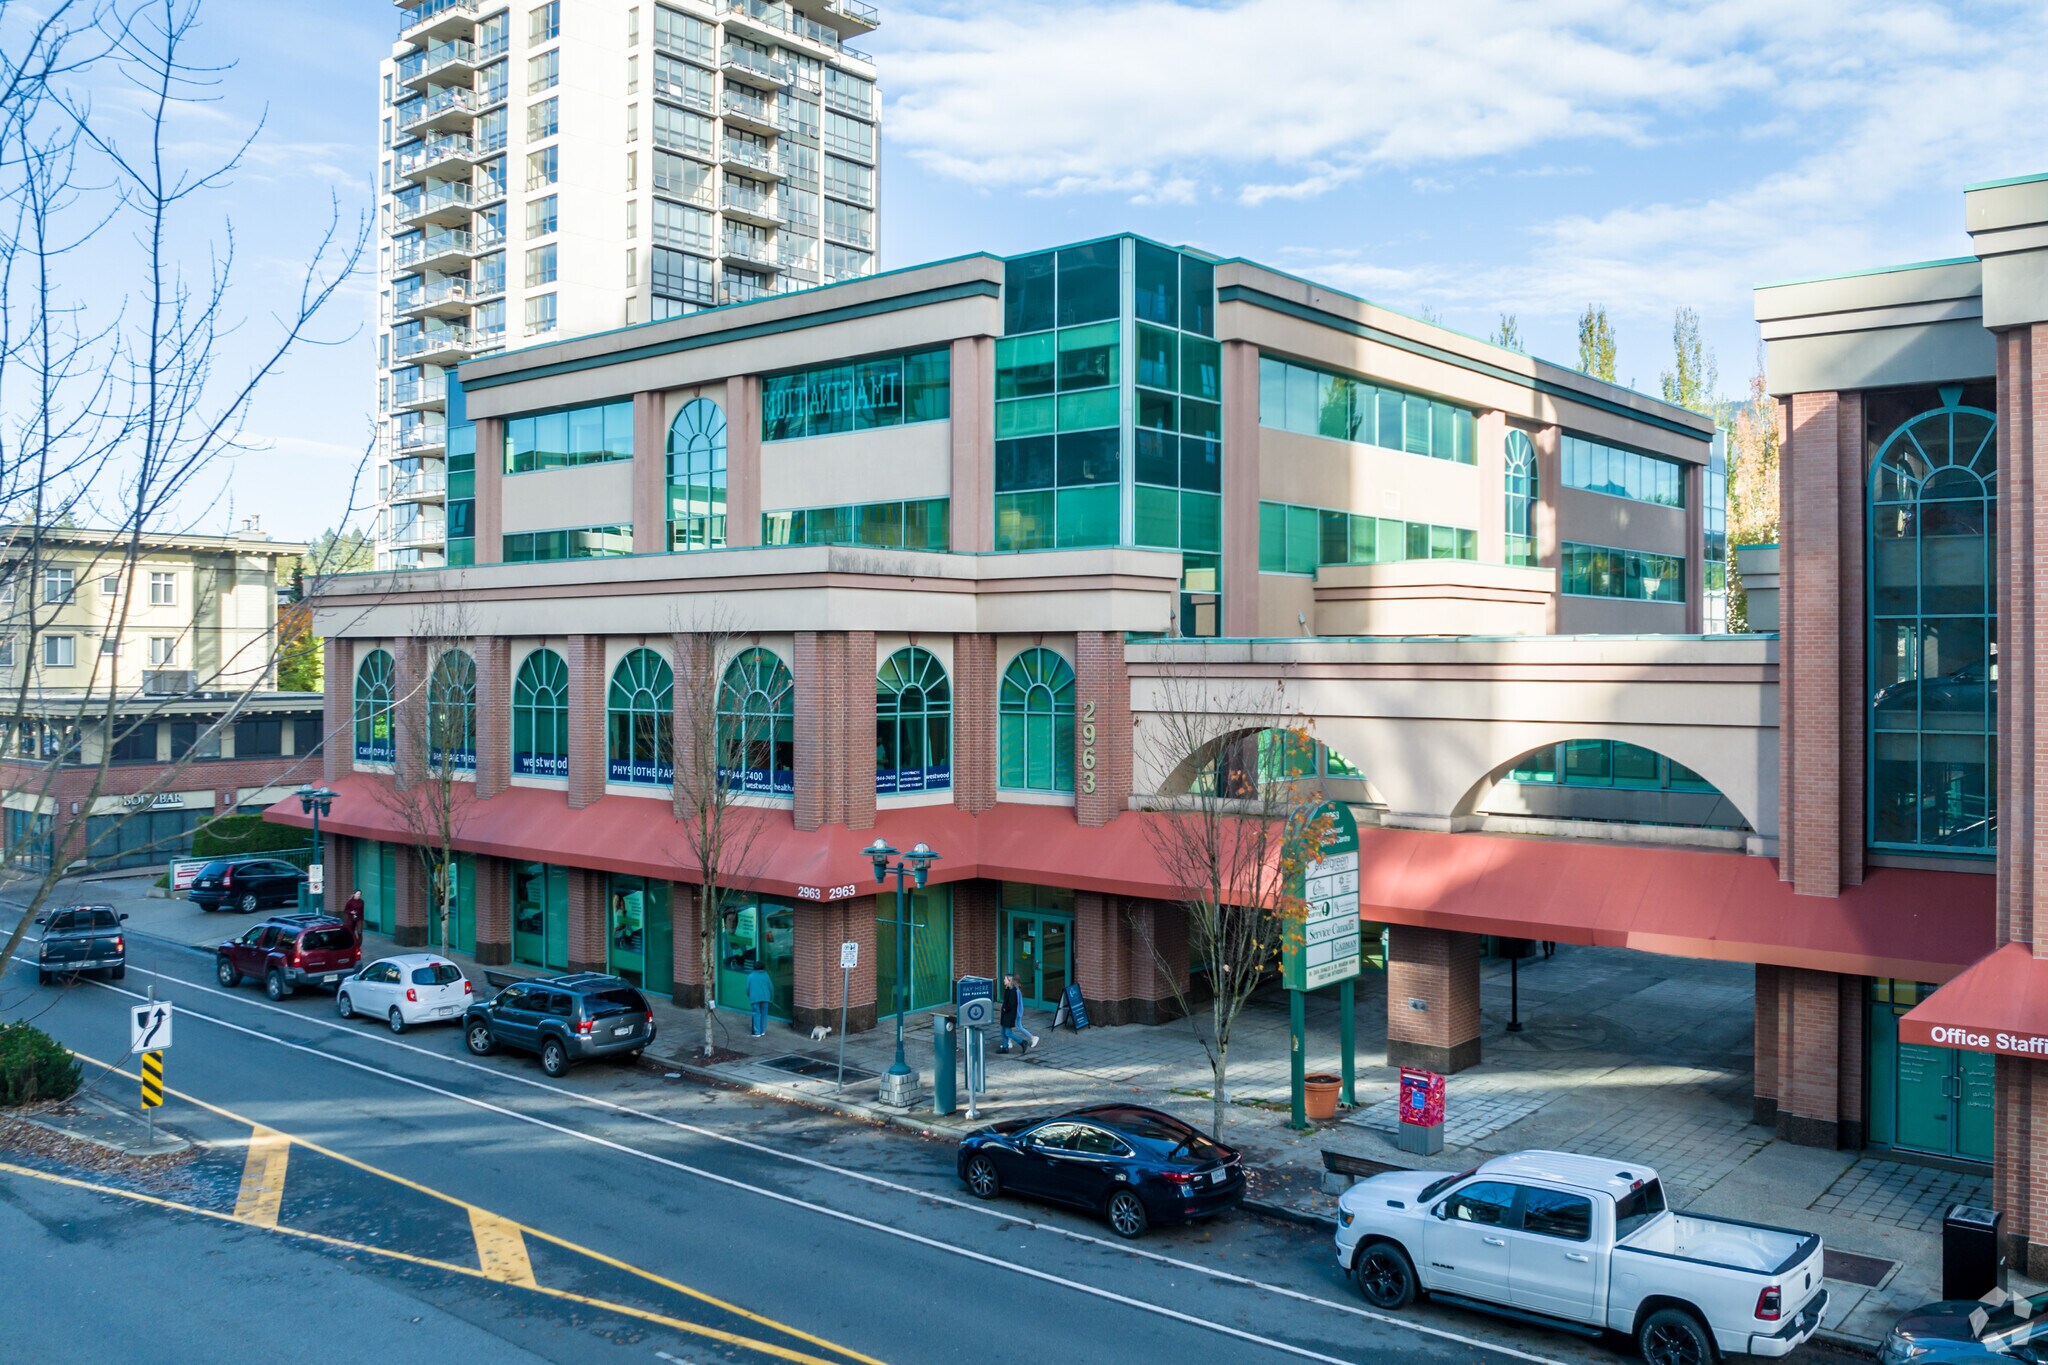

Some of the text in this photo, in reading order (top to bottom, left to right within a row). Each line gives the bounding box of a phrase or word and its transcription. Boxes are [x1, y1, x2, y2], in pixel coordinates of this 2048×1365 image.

[1083, 701, 1096, 794] 2963
[522, 756, 567, 769] westwood
[159, 793, 182, 803] BAR
[797, 884, 856, 899] 2963 2963
[1309, 920, 1354, 940] Service Canada
[1931, 1026, 1990, 1047] Office
